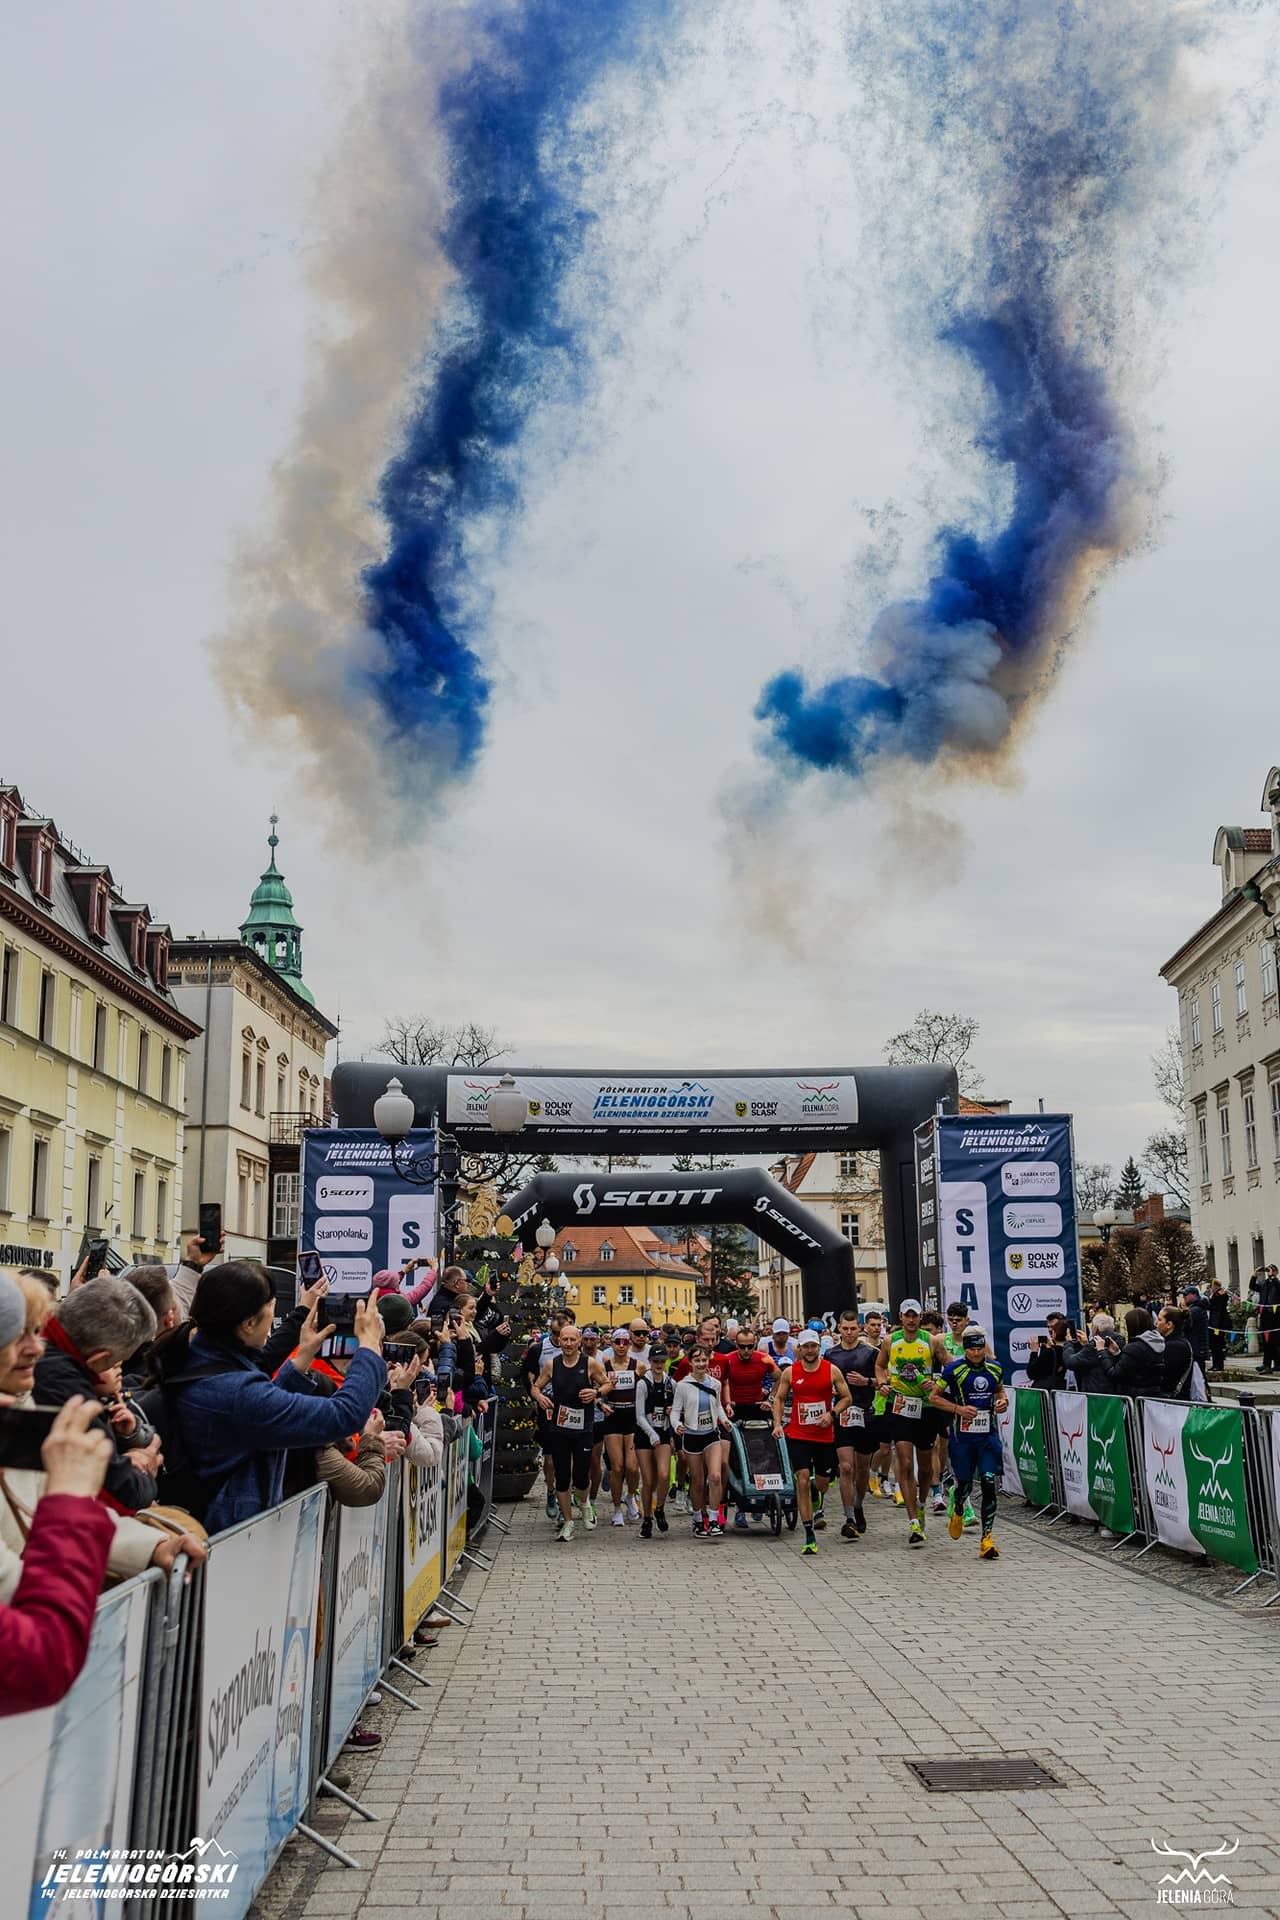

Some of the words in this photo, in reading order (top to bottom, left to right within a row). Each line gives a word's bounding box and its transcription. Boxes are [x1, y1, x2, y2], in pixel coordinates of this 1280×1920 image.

[599, 1086, 668, 1094] PÓŁMARATON
[544, 1101, 573, 1109] DOLNY
[593, 1095, 714, 1110] JELENIOGÓRSKI
[802, 1104, 824, 1113] JELENIA
[960, 1135, 1050, 1149] JELENIOGÓRSKI
[599, 1188, 723, 1207] SCOTT
[317, 1227, 369, 1241] Staropolanka
[765, 1207, 822, 1249] SCOTT
[1027, 1252, 1060, 1261] DOLNY
[1197, 1501, 1219, 1524] JELENIA
[1218, 1505, 1237, 1527] GÓRA
[207, 1625, 277, 1789] Staropolanka
